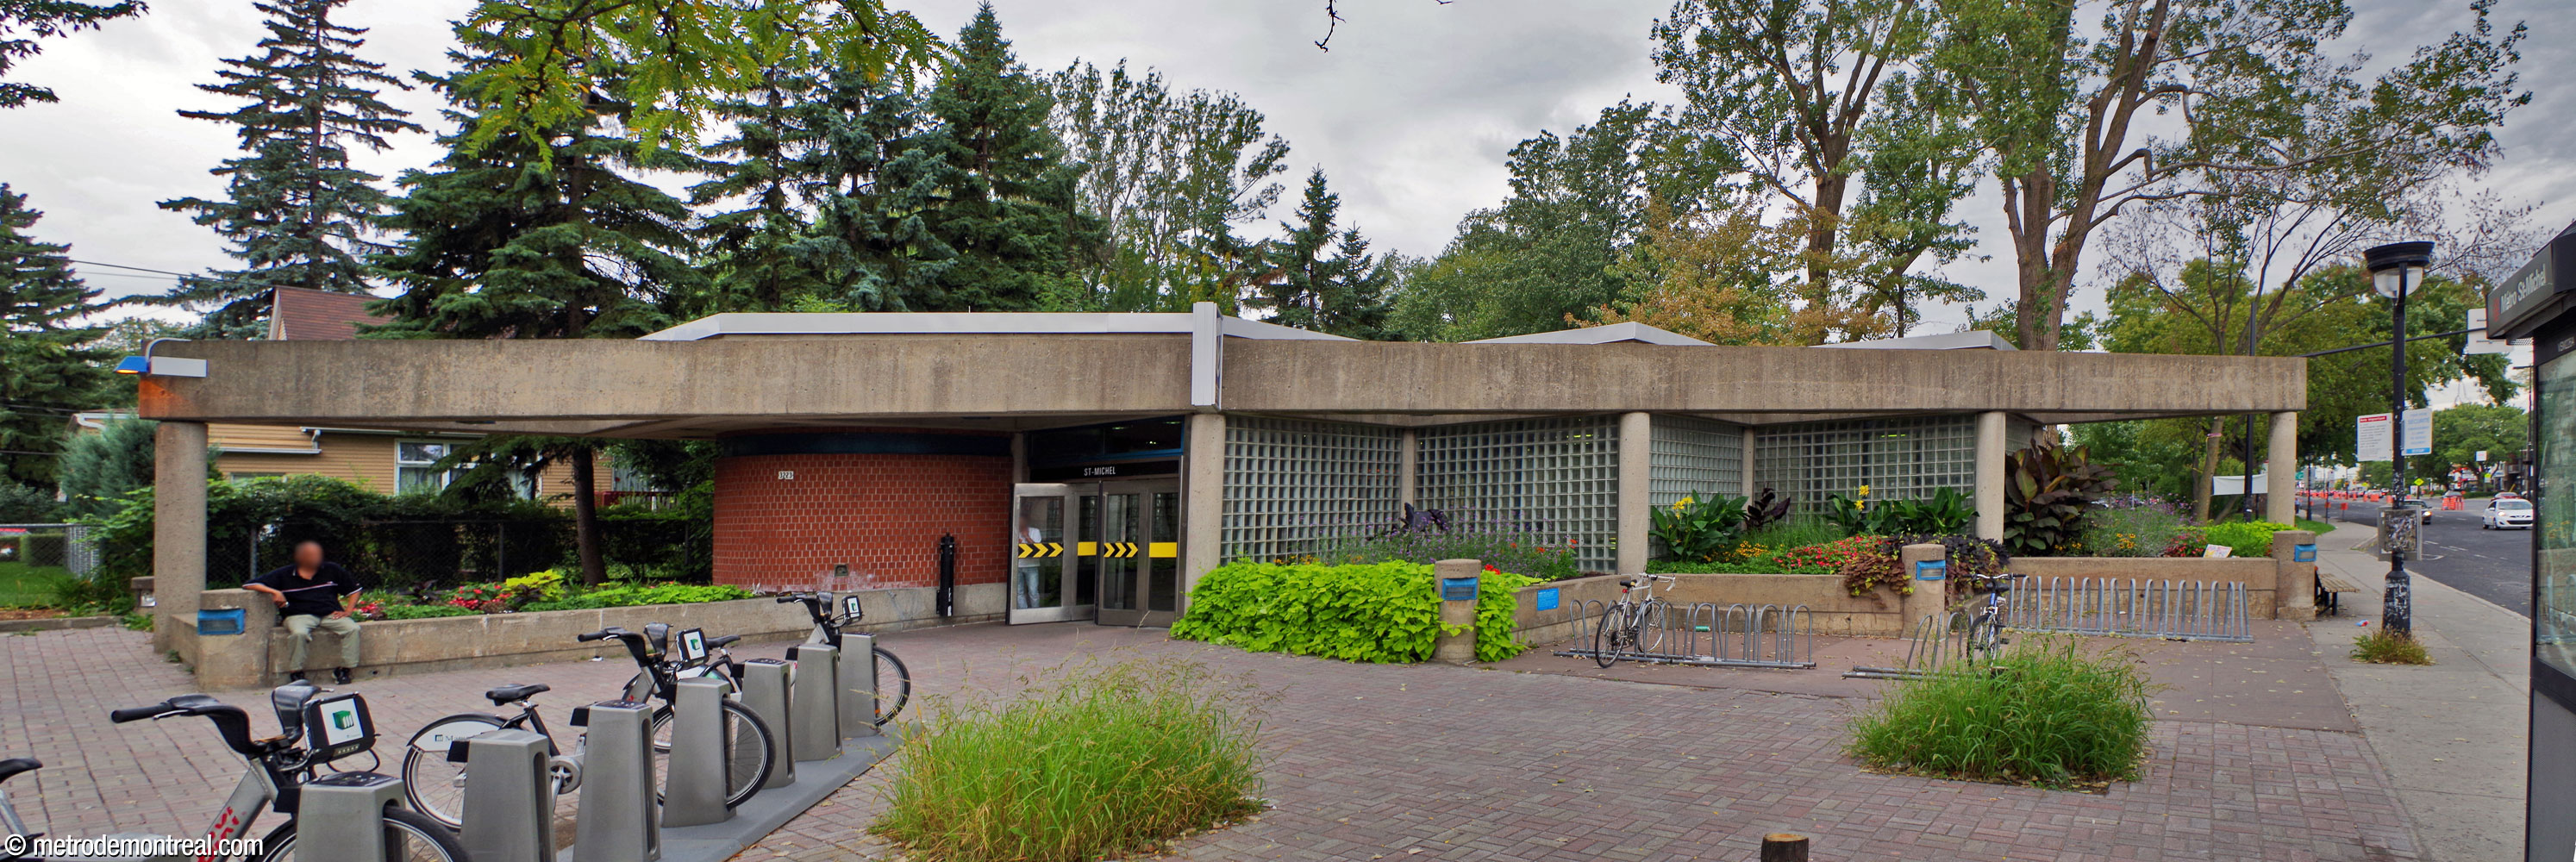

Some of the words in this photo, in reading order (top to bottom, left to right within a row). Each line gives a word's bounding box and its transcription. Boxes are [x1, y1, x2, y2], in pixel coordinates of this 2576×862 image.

[2500, 290, 2517, 314] Métro
[2517, 263, 2546, 302] St-Michel
[1084, 466, 1116, 476] ST-MICHEL
